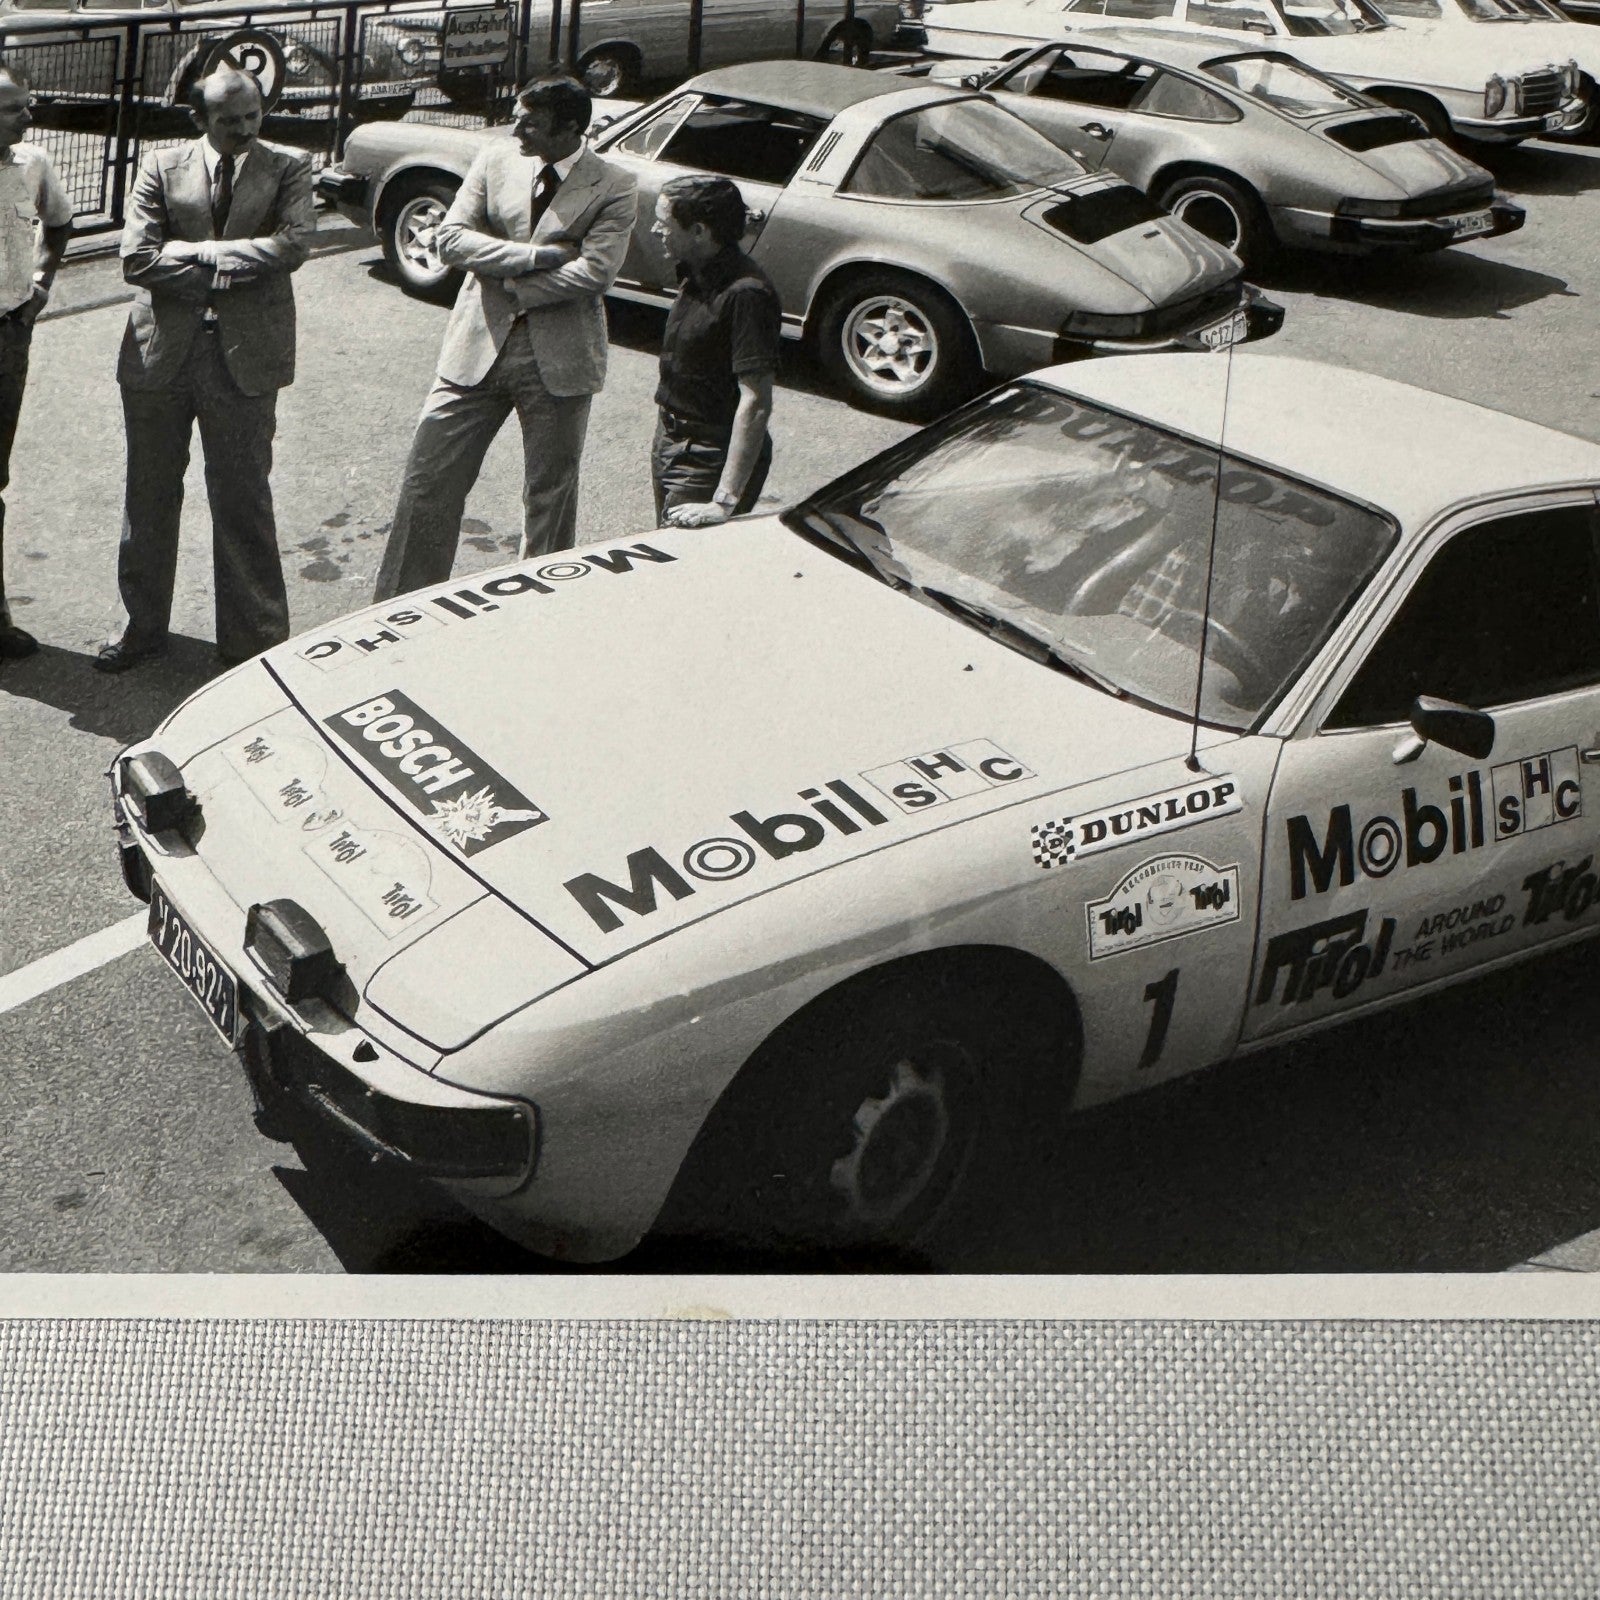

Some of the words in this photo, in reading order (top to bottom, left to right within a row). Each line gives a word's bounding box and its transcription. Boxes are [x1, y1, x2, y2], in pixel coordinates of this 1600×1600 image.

[431, 543, 679, 620] Mobil
[340, 697, 475, 795] BOSCH
[563, 780, 888, 934] Mobil
[892, 752, 1023, 807] SHC
[1081, 782, 1235, 845] DUNLOP
[1286, 770, 1484, 900] Mobil
[1499, 758, 1580, 834] SHC
[381, 882, 423, 919] Tirol
[1415, 894, 1506, 940] AROUND
[1393, 941, 1435, 971] THE
[1442, 914, 1515, 957] WORLD
[1137, 968, 1180, 1070] 1
